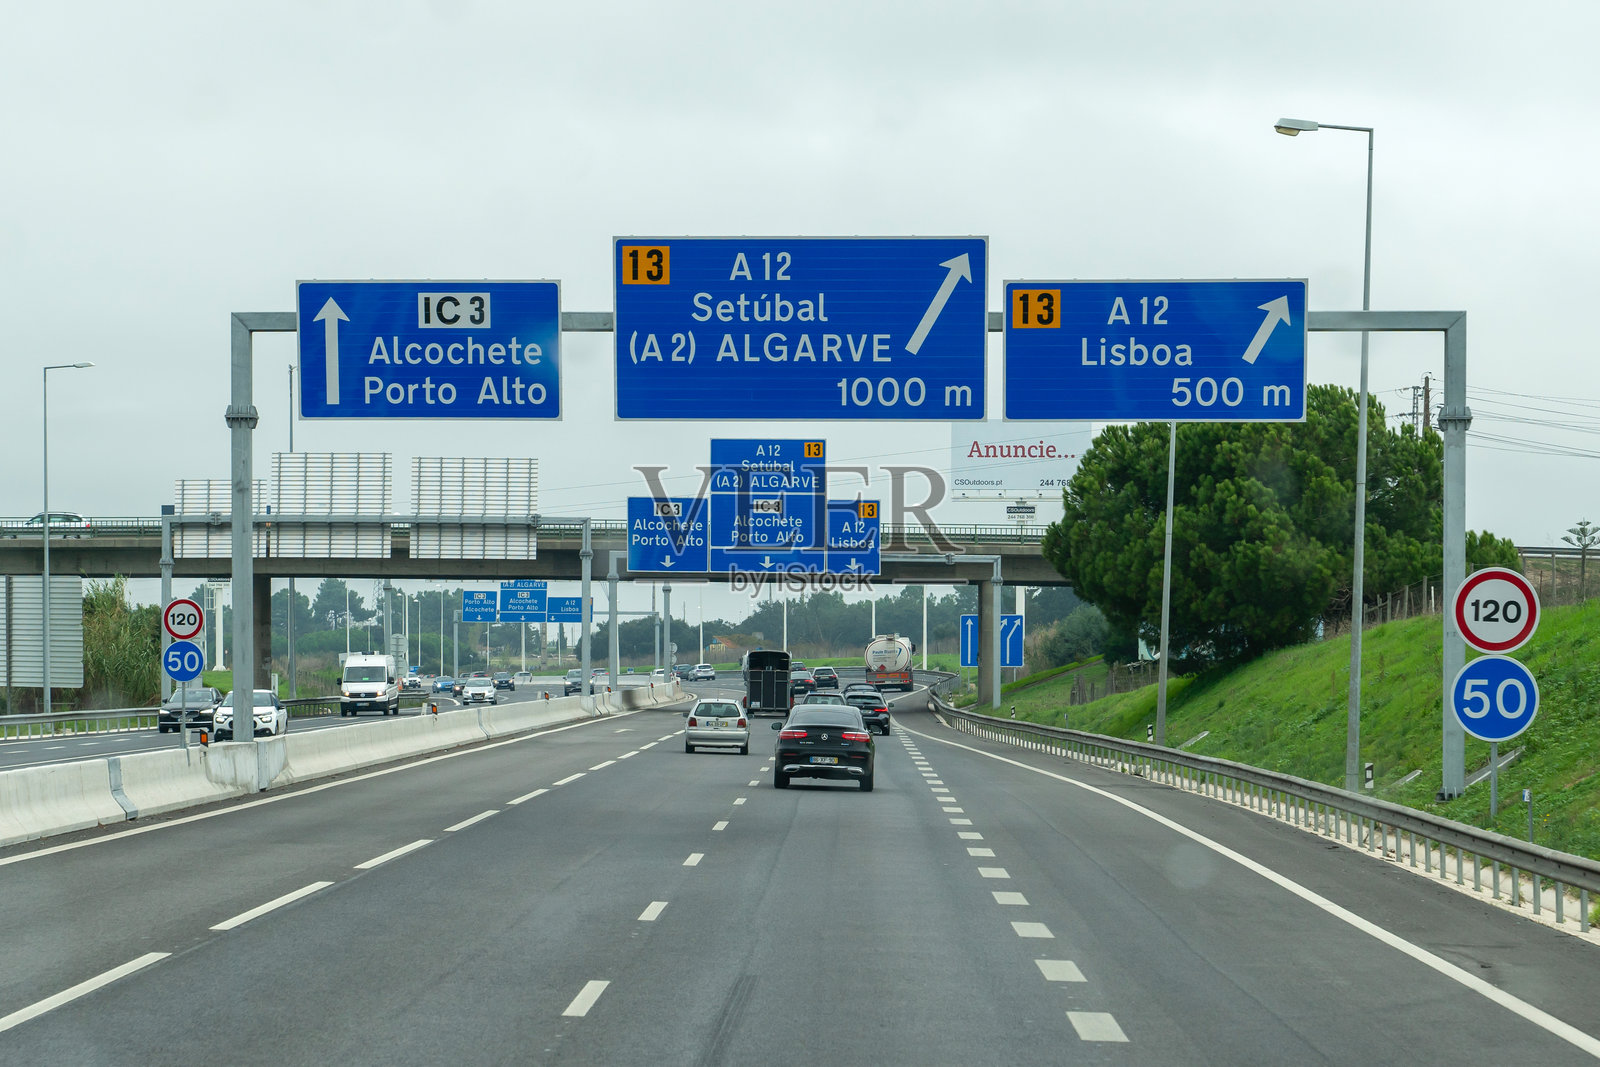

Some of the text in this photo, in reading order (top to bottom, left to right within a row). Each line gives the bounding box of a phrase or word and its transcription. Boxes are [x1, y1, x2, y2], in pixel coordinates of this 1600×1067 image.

[628, 249, 664, 281] 13
[730, 252, 792, 280] A 12
[424, 296, 485, 325] IC 3
[692, 292, 828, 322] Setúbal
[1019, 293, 1054, 325] 13
[1107, 296, 1168, 325] A 12
[368, 336, 542, 365] Alcochete
[630, 330, 892, 364] (A 2) ALGARVE
[1082, 337, 1193, 366] Lisboa
[364, 376, 547, 404] Porto Alto
[837, 377, 972, 406] 1000 m
[1171, 377, 1290, 407] 500 m
[756, 444, 780, 456] A 12
[806, 444, 820, 456] 13
[967, 440, 1075, 458] Anuncie...
[741, 460, 795, 472] Setúbal
[716, 475, 819, 488] (A 2) ALGARVE
[656, 504, 680, 515] IC 3
[756, 501, 780, 512] IC 3
[861, 504, 875, 517] 13
[634, 519, 703, 531] Alcochete
[733, 515, 802, 527] Alcochete
[842, 522, 865, 533] A 12
[632, 534, 704, 546] Porto Alto
[731, 530, 804, 543] Porto Alto
[832, 537, 875, 549] Lisboa
[170, 613, 197, 626] 120
[1471, 599, 1522, 624] 120
[168, 651, 199, 672] 50
[1463, 678, 1527, 719] 50
